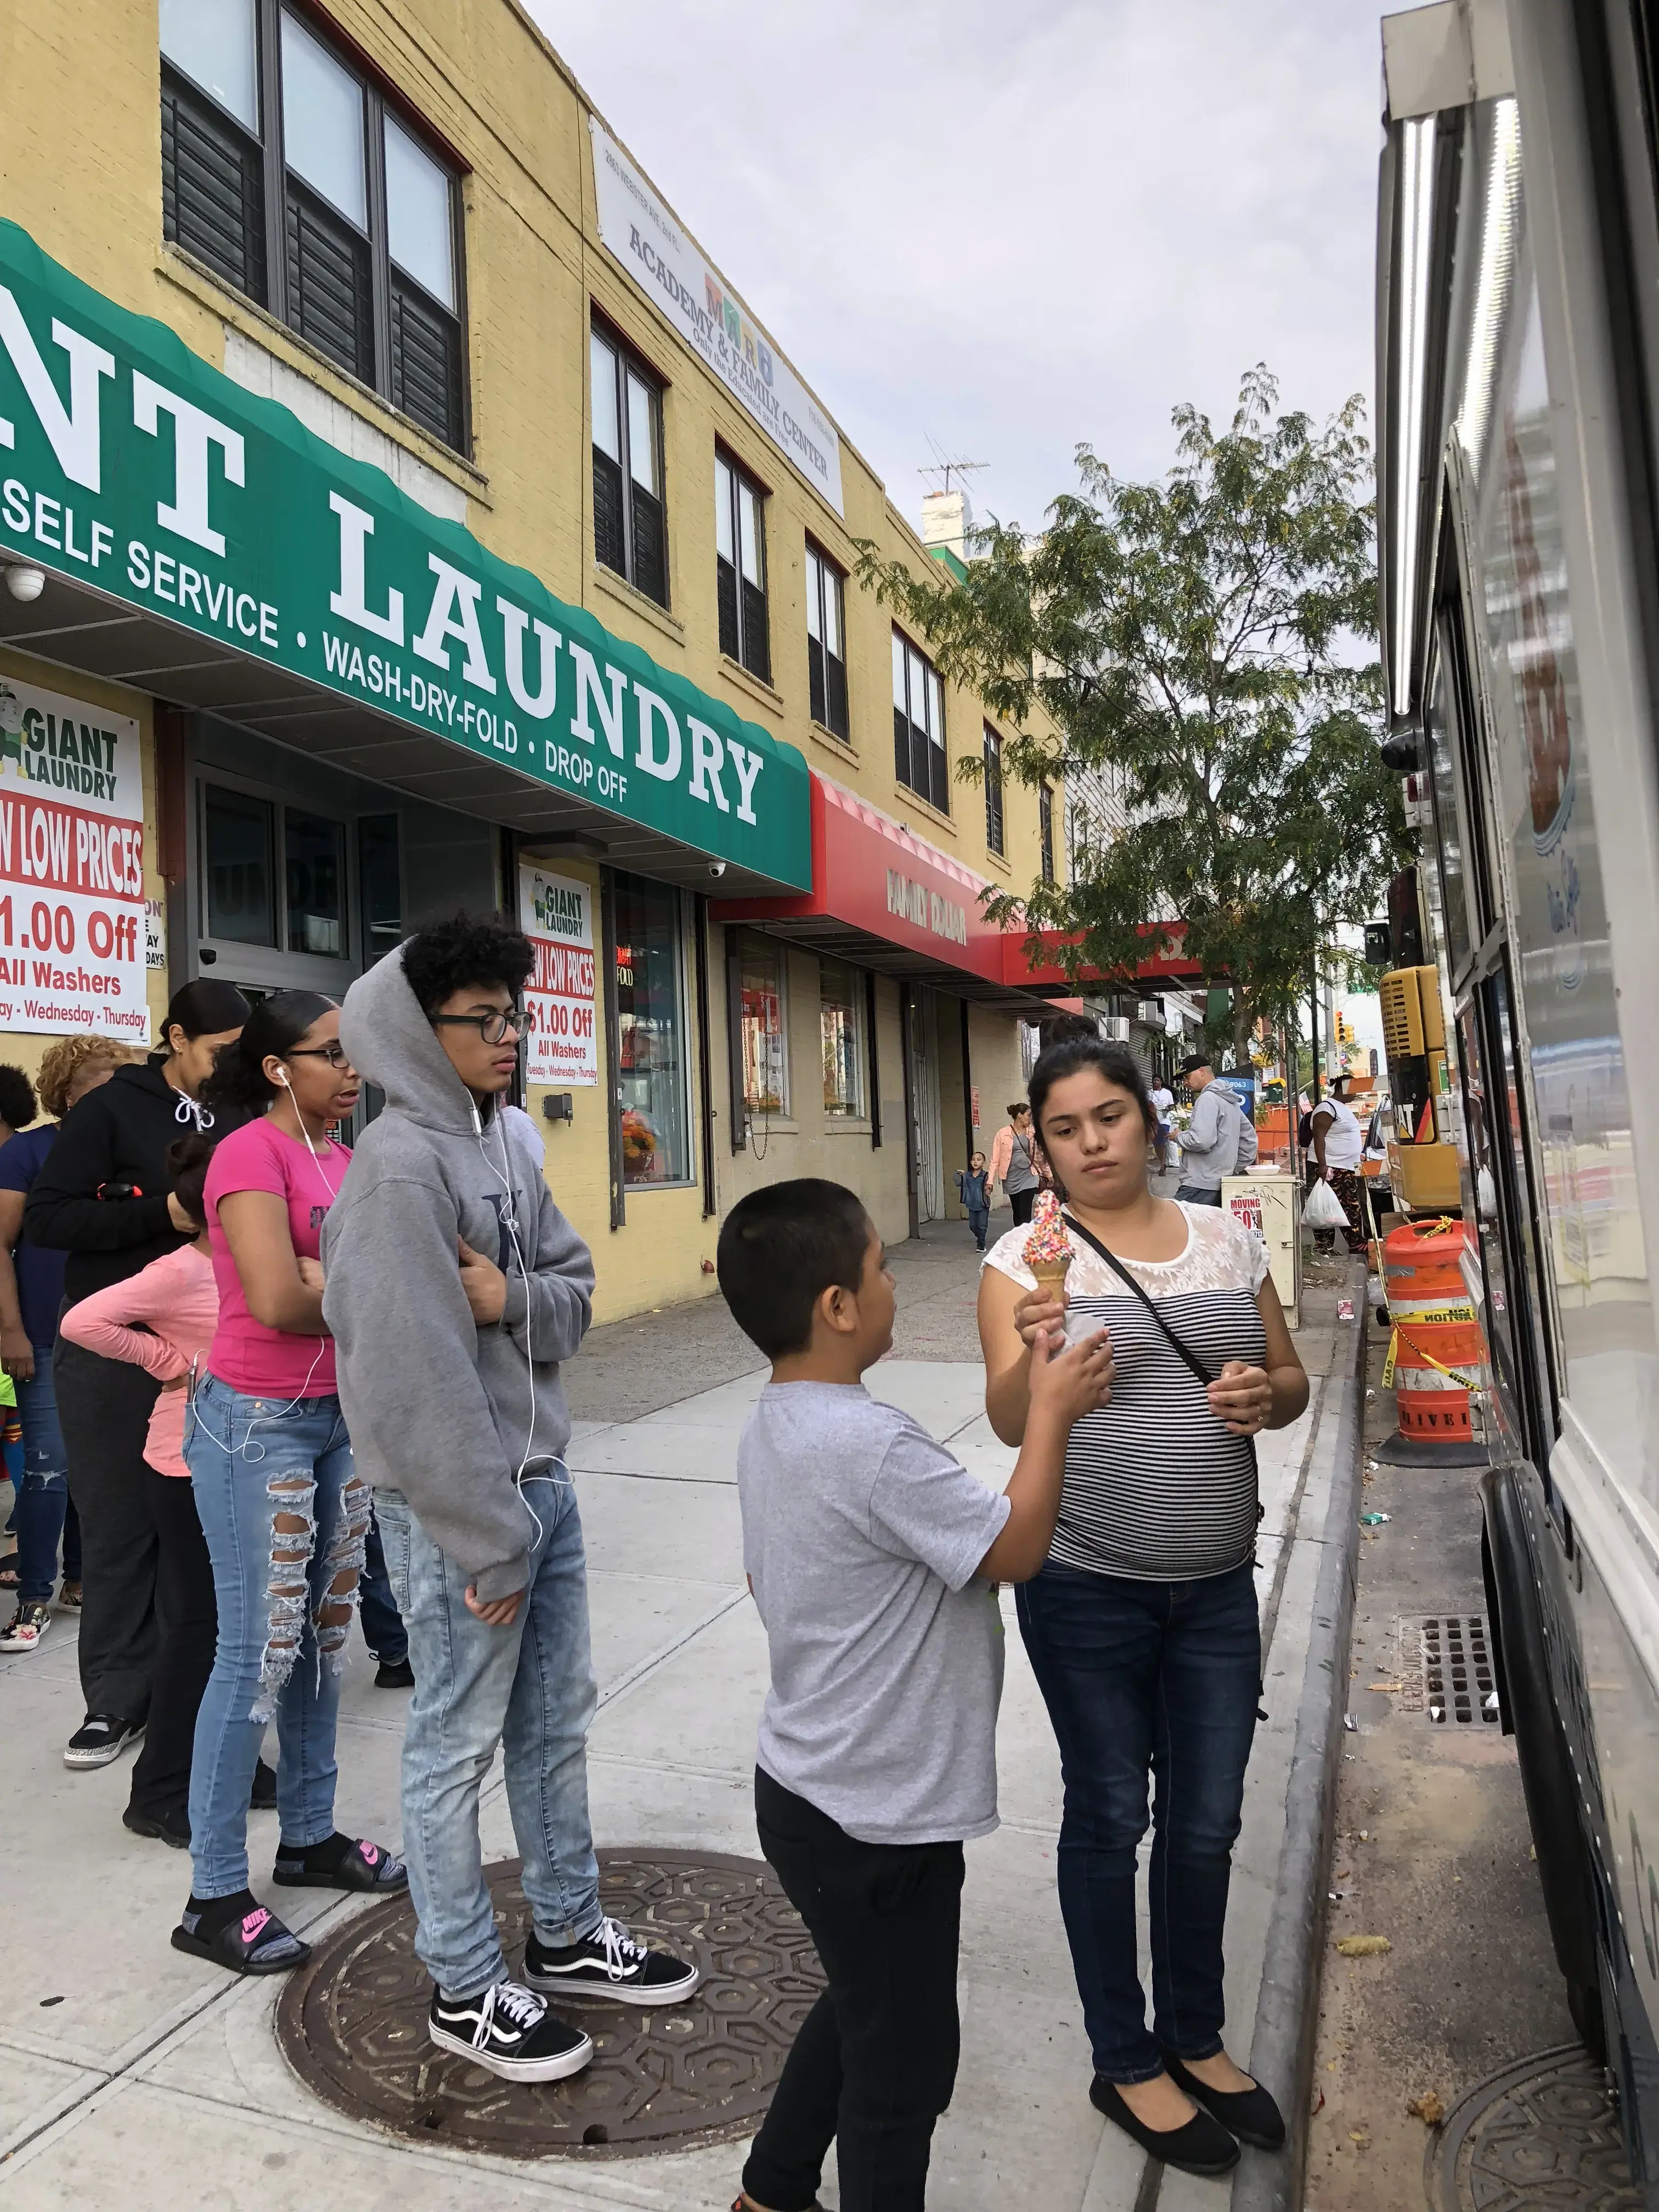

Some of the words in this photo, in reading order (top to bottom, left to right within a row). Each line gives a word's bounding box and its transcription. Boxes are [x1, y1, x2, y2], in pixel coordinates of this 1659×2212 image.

[620, 167, 648, 211] WEBSTER
[662, 222, 671, 241] 2nd
[629, 223, 714, 344] ACADEMY
[719, 332, 729, 363] &
[732, 347, 780, 422] FAMILY
[783, 411, 828, 481] CENTER
[693, 328, 712, 359] Only
[714, 352, 726, 374] the
[728, 369, 761, 415] Educated
[763, 413, 774, 429] are
[774, 422, 789, 447] Free
[2, 478, 114, 567] SELF
[127, 541, 278, 648] SERVICE
[323, 632, 518, 755] WASH-DRY-FOLD
[545, 740, 594, 792] DROP
[598, 769, 628, 803] OFF
[329, 490, 764, 827] LAUNDRY
[23, 708, 118, 773] GIANT
[25, 755, 117, 802] LAUNDRY
[20, 807, 70, 883] LOW
[76, 817, 142, 897] PRICES
[546, 885, 582, 919] GIANT
[546, 913, 583, 938] LAUNDRY
[887, 867, 928, 929] FAMILY
[931, 892, 968, 947] DOLLAR
[87, 911, 137, 962] Off
[146, 934, 159, 948] AY
[0, 957, 25, 986] All
[32, 961, 121, 996] Washers
[545, 946, 565, 991] LOW
[567, 950, 595, 996] PRICES
[24, 1000, 94, 1026] Wednesday
[103, 1007, 146, 1031] Thursday
[527, 999, 568, 1036] $1.00
[572, 1007, 592, 1037] Off
[527, 1063, 545, 1078] Tuesday
[549, 1064, 576, 1079] Wednesday
[579, 1066, 597, 1080] Thursday
[538, 1040, 549, 1057] All
[551, 1041, 586, 1059] Washers
[1230, 1198, 1260, 1209] MOVING
[242, 1908, 268, 1930] NIKE
